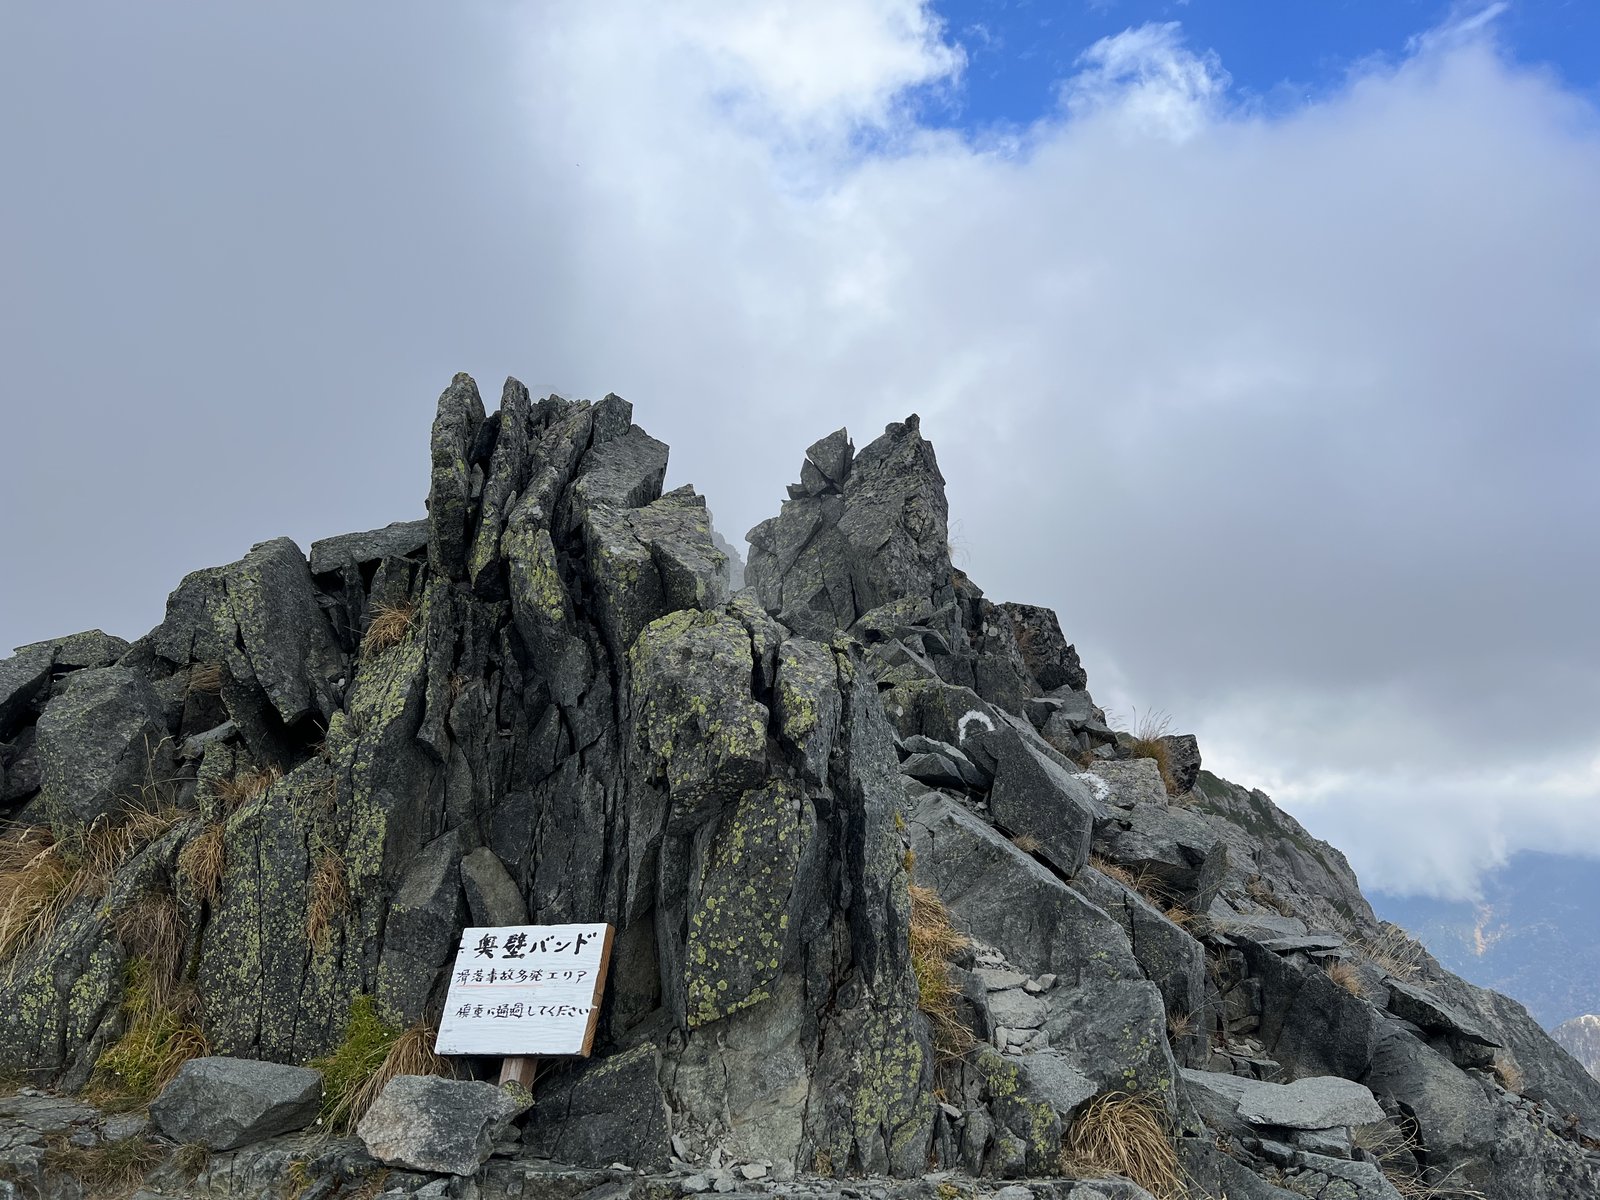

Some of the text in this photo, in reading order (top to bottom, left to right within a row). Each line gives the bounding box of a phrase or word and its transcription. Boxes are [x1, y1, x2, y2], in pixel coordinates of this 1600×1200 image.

[474, 932, 597, 960] 奥壁バンド
